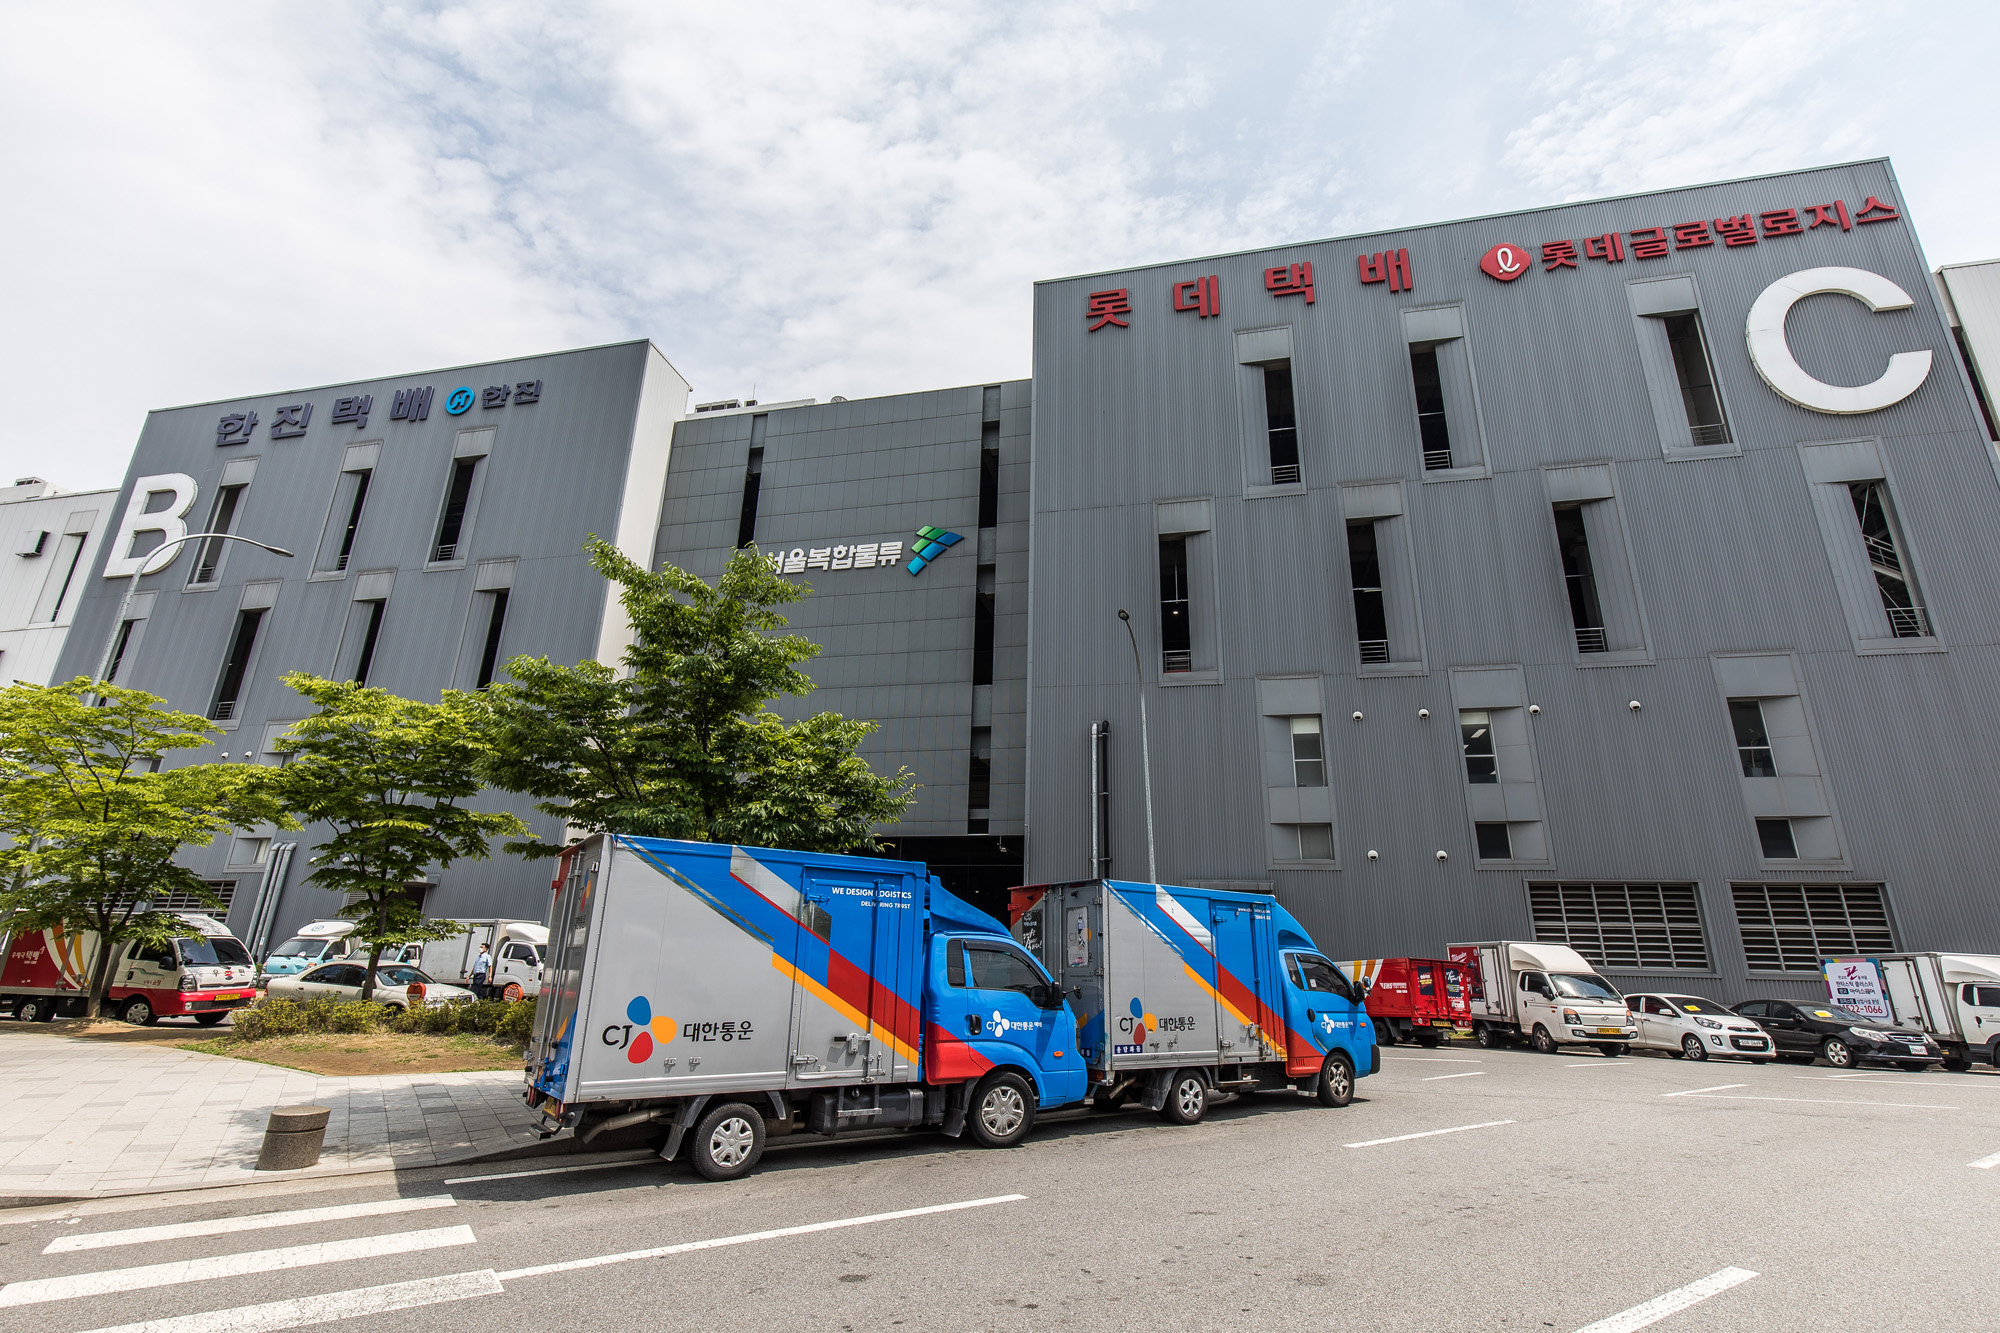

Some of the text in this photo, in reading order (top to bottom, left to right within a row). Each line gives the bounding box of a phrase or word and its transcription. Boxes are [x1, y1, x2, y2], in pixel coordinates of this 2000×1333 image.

[1540, 195, 1901, 273] 롯데글로벌로지스
[1085, 248, 1413, 332] 롯데택배
[1745, 265, 1933, 416] C
[481, 379, 543, 408] 한진
[215, 385, 435, 447] 한진택배
[102, 472, 199, 579] B
[831, 887, 912, 899] WE DESIGN LOGISTICS
[860, 900, 893, 908] DELIVRING
[682, 1020, 754, 1042] 대한통운
[986, 1021, 996, 1031] CJ
[1010, 1021, 1034, 1031] 대한통운
[1119, 1017, 1134, 1034] CJ
[1158, 1016, 1196, 1031] 대한통운
[602, 1024, 633, 1050] CJ
